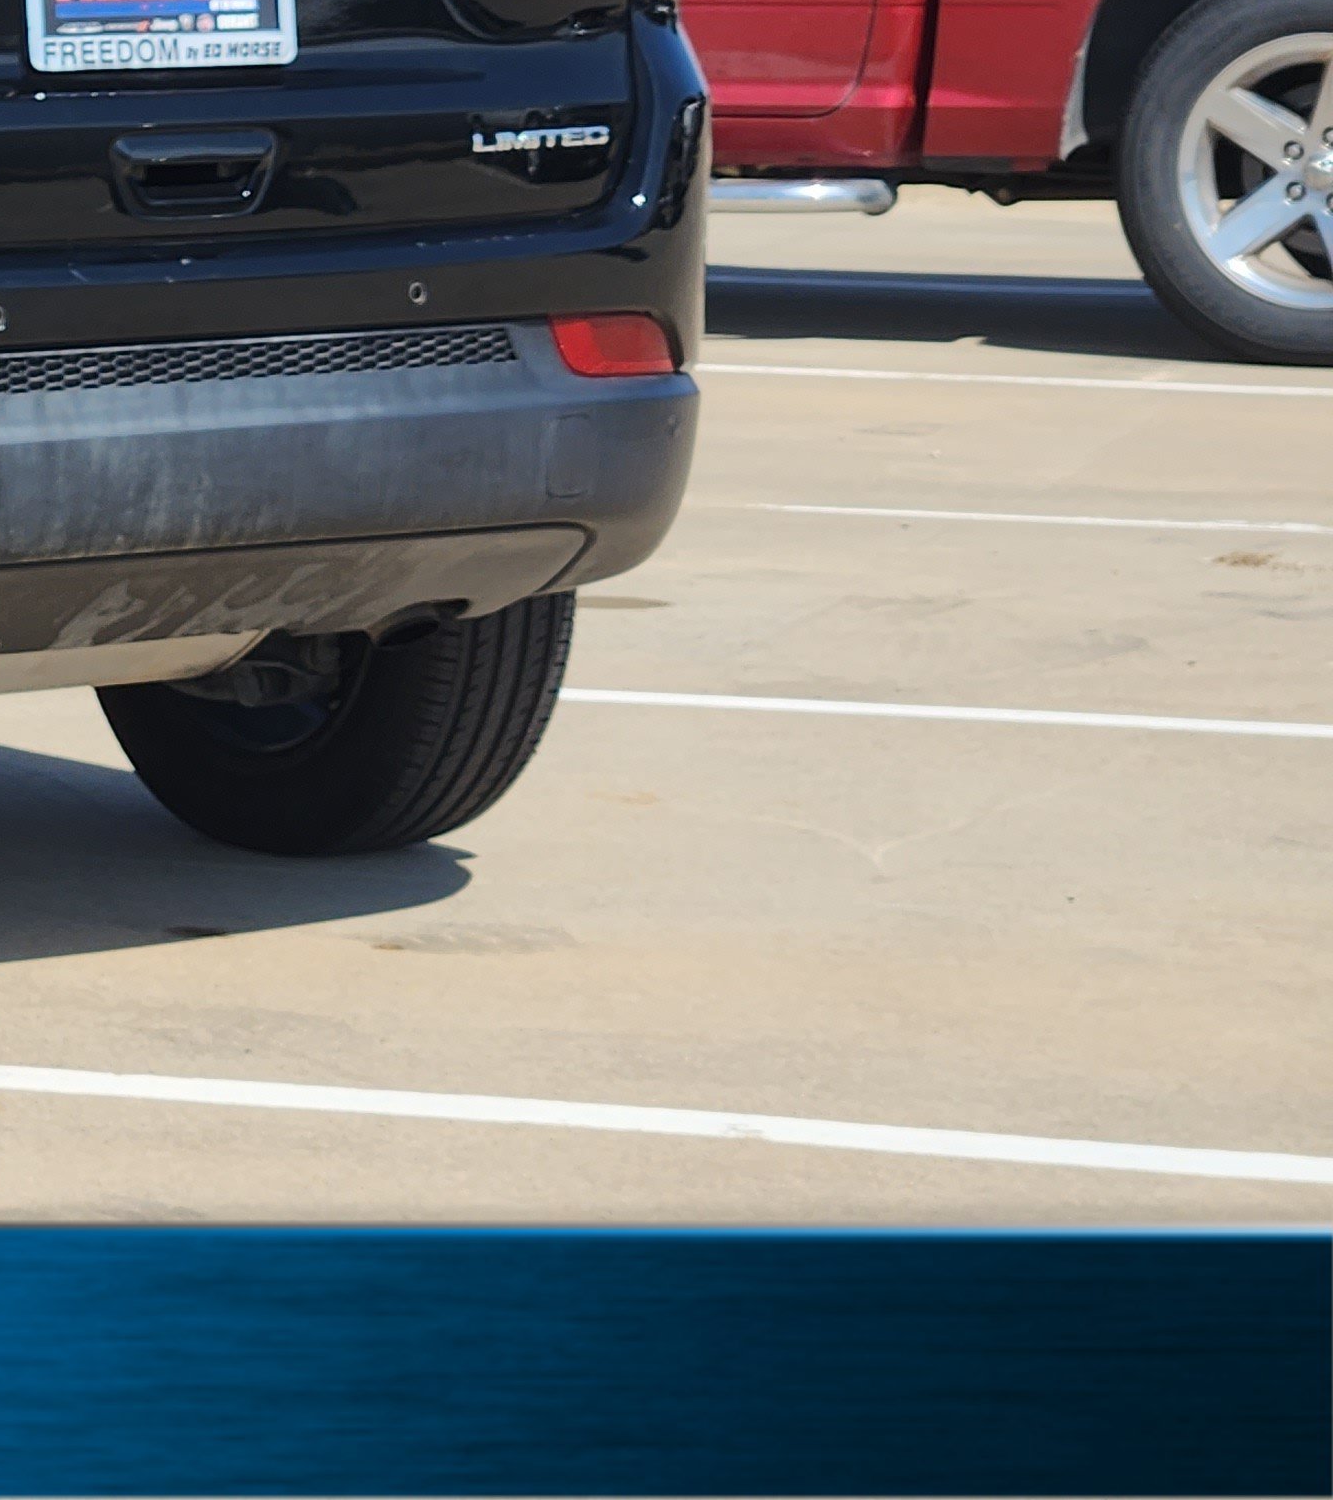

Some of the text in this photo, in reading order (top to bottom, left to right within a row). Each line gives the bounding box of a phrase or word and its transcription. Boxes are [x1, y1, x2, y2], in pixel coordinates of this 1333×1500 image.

[43, 38, 180, 66] FREEDOM
[203, 43, 222, 58] ED
[225, 41, 282, 58] MORSE
[472, 125, 611, 153] LIMITED
